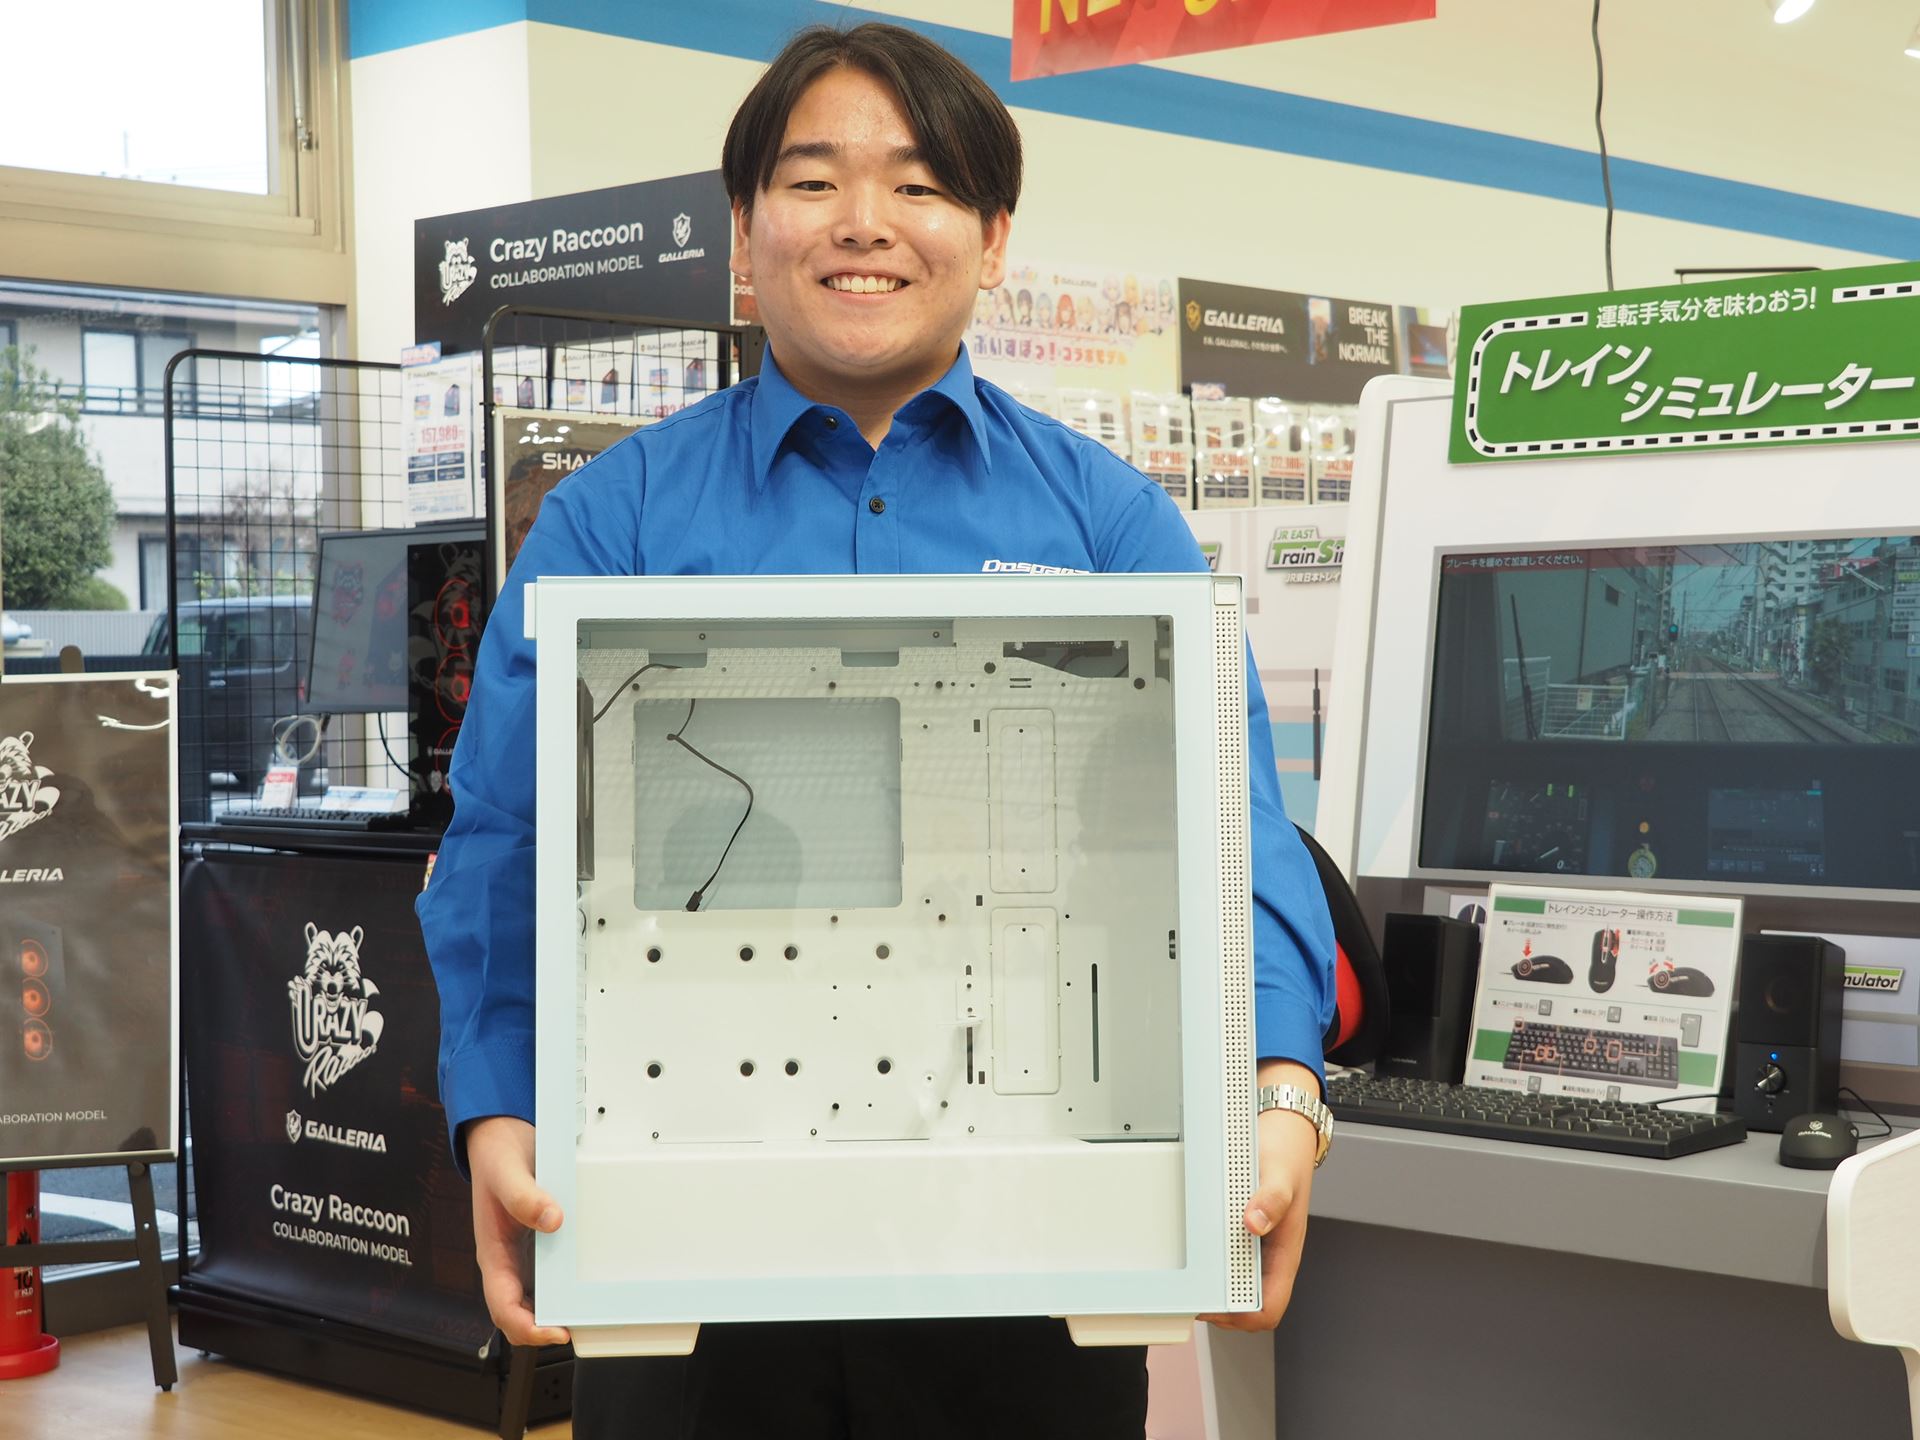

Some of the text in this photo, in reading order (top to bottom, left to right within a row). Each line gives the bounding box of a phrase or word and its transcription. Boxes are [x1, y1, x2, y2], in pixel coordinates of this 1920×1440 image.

[490, 222, 644, 263] Crazy Raccoon
[658, 248, 705, 263] GALLERIA
[490, 254, 643, 289] COLLABORATION MODEL
[1204, 309, 1285, 334] GALLERIA
[1349, 306, 1389, 328] BREAK
[1596, 287, 1817, 329] 運転手気分を味わおう!
[1365, 328, 1389, 346] THE
[1339, 343, 1390, 365] NORMAL
[1500, 344, 1652, 394] トレイン
[1620, 362, 1916, 423] シミュレーター
[541, 453, 594, 471] SHA
[1291, 529, 1315, 540] EAST
[65, 1110, 107, 1121] MODEL
[305, 1120, 387, 1153] GALLERIA
[270, 1183, 410, 1236] Crazy Raccoon
[273, 1220, 413, 1266] COLLABORATION MODEL
